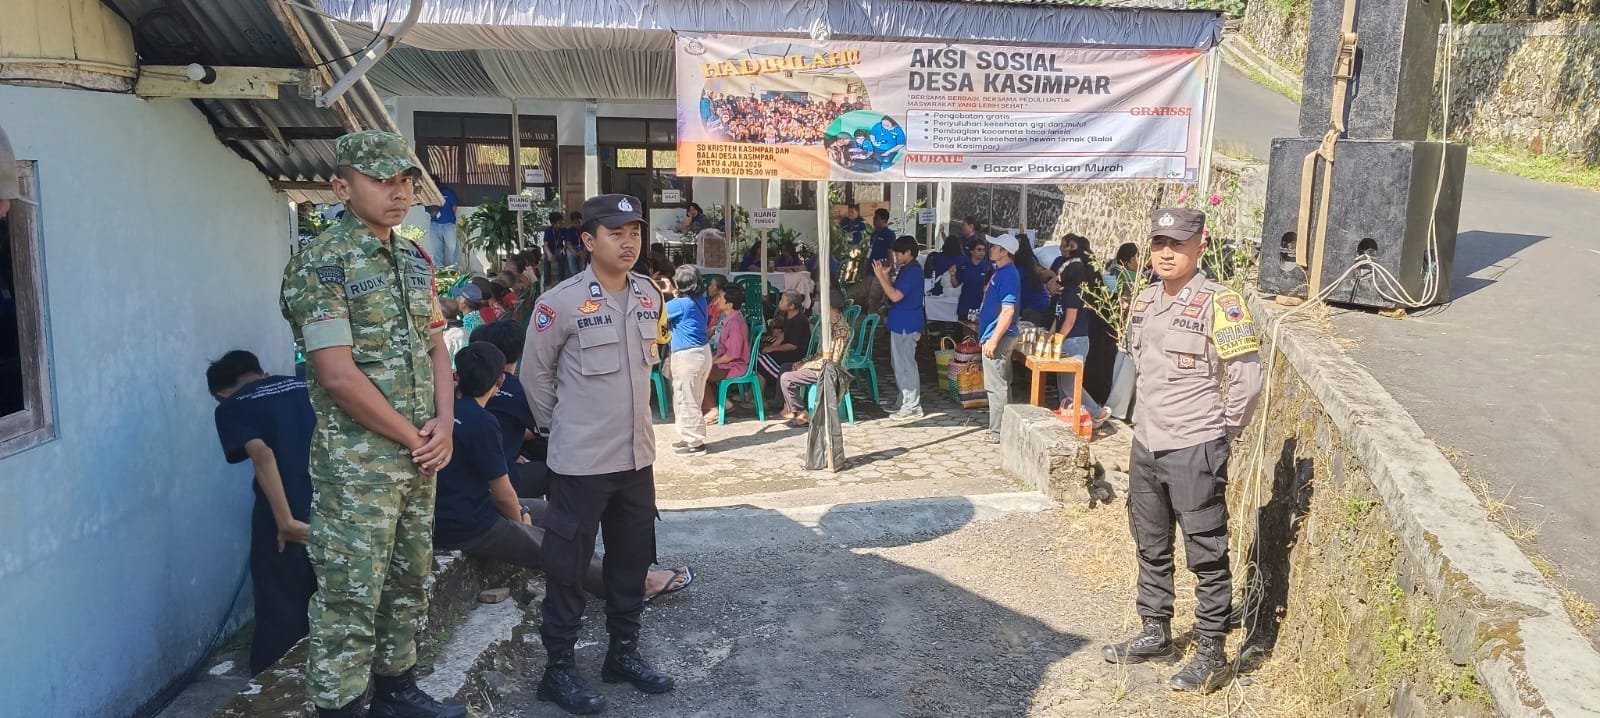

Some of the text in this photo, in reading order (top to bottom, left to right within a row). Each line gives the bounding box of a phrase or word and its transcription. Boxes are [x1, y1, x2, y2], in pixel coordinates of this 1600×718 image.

[910, 48, 1063, 73] AKSI SOSIAL
[908, 70, 1112, 95] DESA KASIMPAR
[933, 112, 1010, 121] Pengobatan gratis
[933, 120, 982, 128] Penyuluhan
[1030, 121, 1045, 129] gigi
[933, 127, 980, 135] Pembagian
[933, 135, 982, 143] Penyuluhan
[707, 144, 737, 152] KRISTEN
[738, 145, 774, 154] KASIMPAR
[956, 143, 1000, 151] Kasimpar)
[719, 152, 737, 160] DESA
[738, 153, 776, 162] KASIMPAR,
[983, 162, 1124, 173] Bazar Pakaian Murah
[410, 276, 426, 286] TNI
[1172, 318, 1205, 332] POLRI
